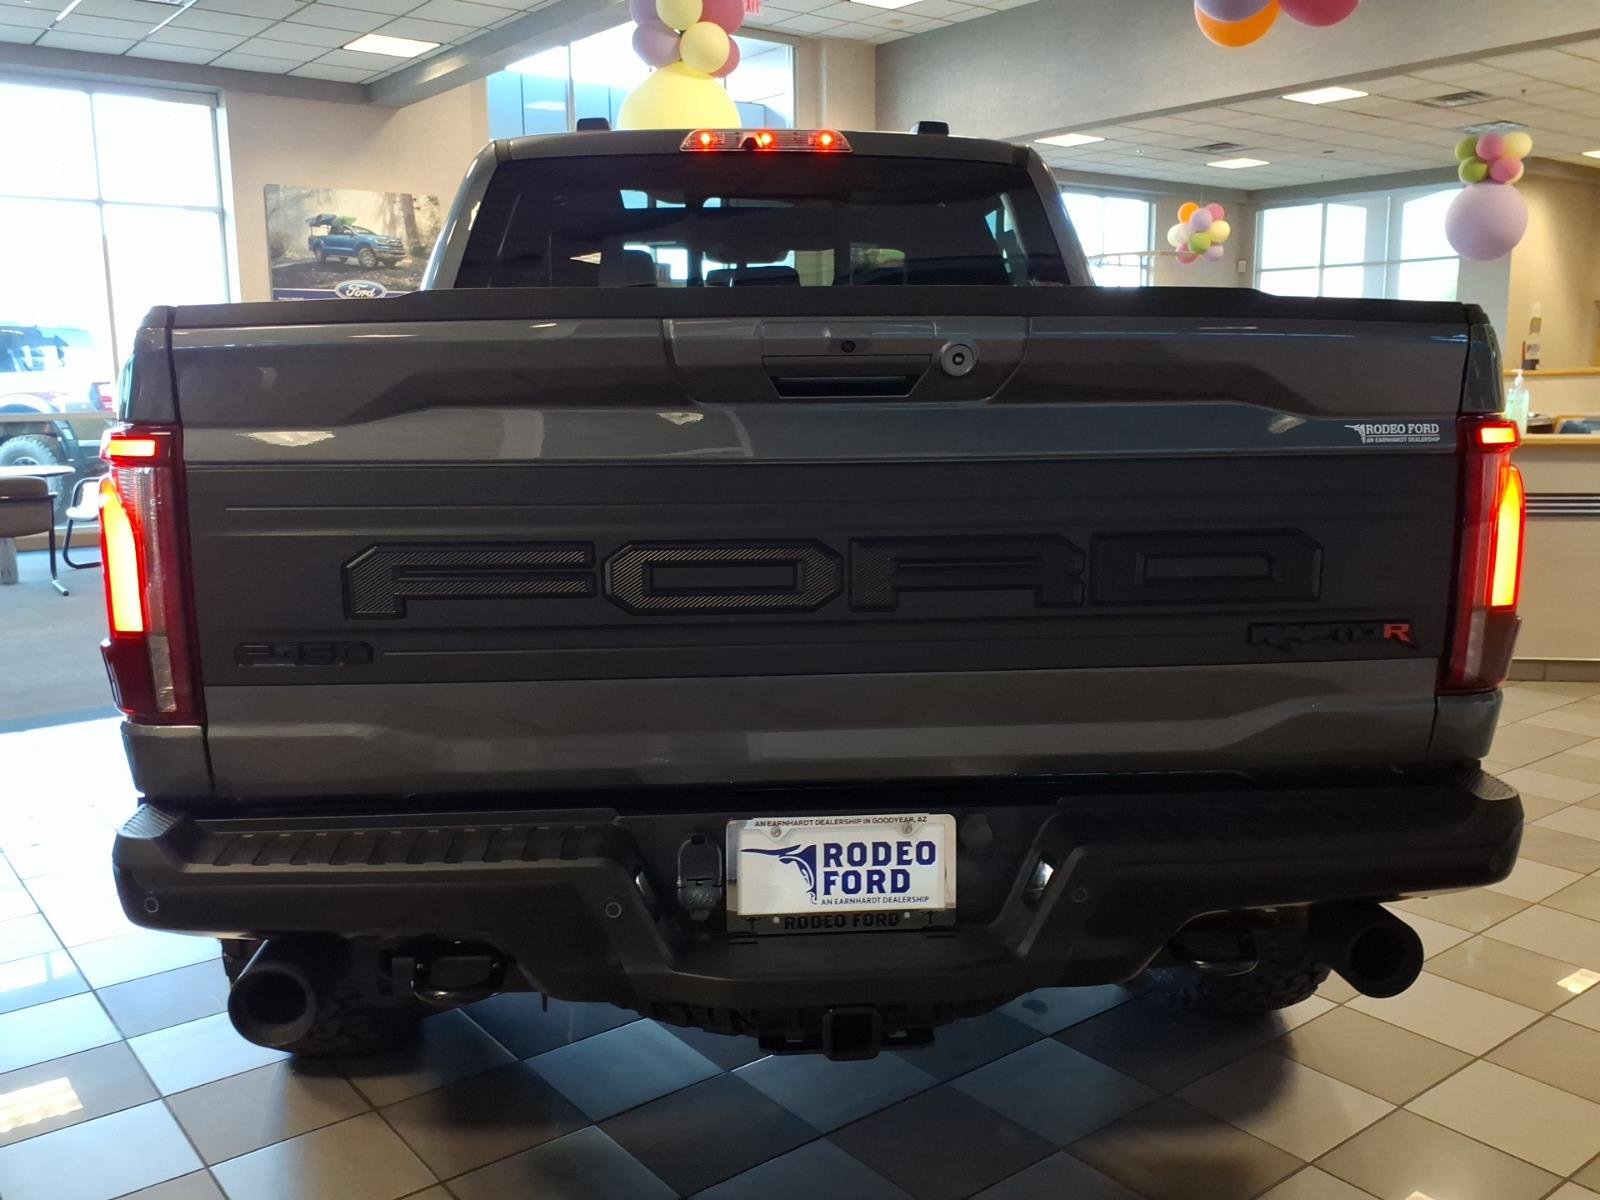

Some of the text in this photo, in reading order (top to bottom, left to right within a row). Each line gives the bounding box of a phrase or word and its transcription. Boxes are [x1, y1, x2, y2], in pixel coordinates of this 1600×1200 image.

[346, 284, 376, 299] Ford
[1366, 423, 1440, 435] RODEO FORD
[343, 529, 1322, 618] FORD
[767, 819, 815, 827] EARNHARDT
[815, 818, 862, 826] DEALERSHIP
[917, 815, 928, 823] AZ
[823, 841, 936, 868] RODEO
[823, 868, 911, 896] FORD
[834, 897, 881, 905] EARNHARDT
[882, 896, 930, 904] DEALERSHIP
[784, 912, 900, 930] RODEO FORD
